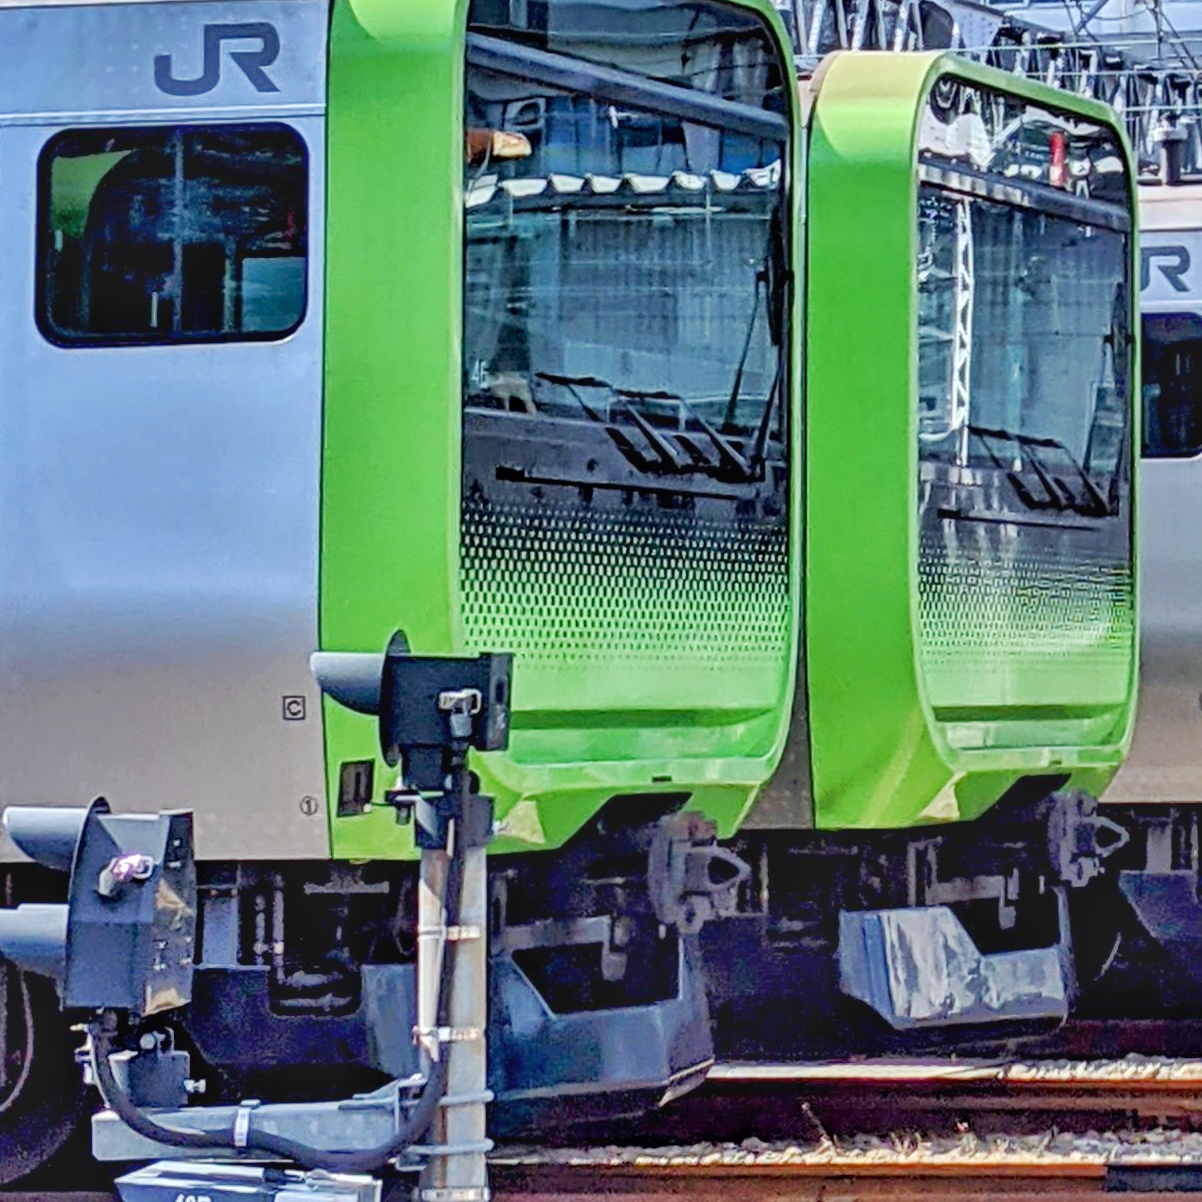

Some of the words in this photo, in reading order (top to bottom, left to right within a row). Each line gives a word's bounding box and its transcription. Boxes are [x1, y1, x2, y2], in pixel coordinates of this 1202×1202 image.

[154, 22, 281, 96] JR
[1140, 245, 1191, 292] R
[285, 698, 304, 718] C
